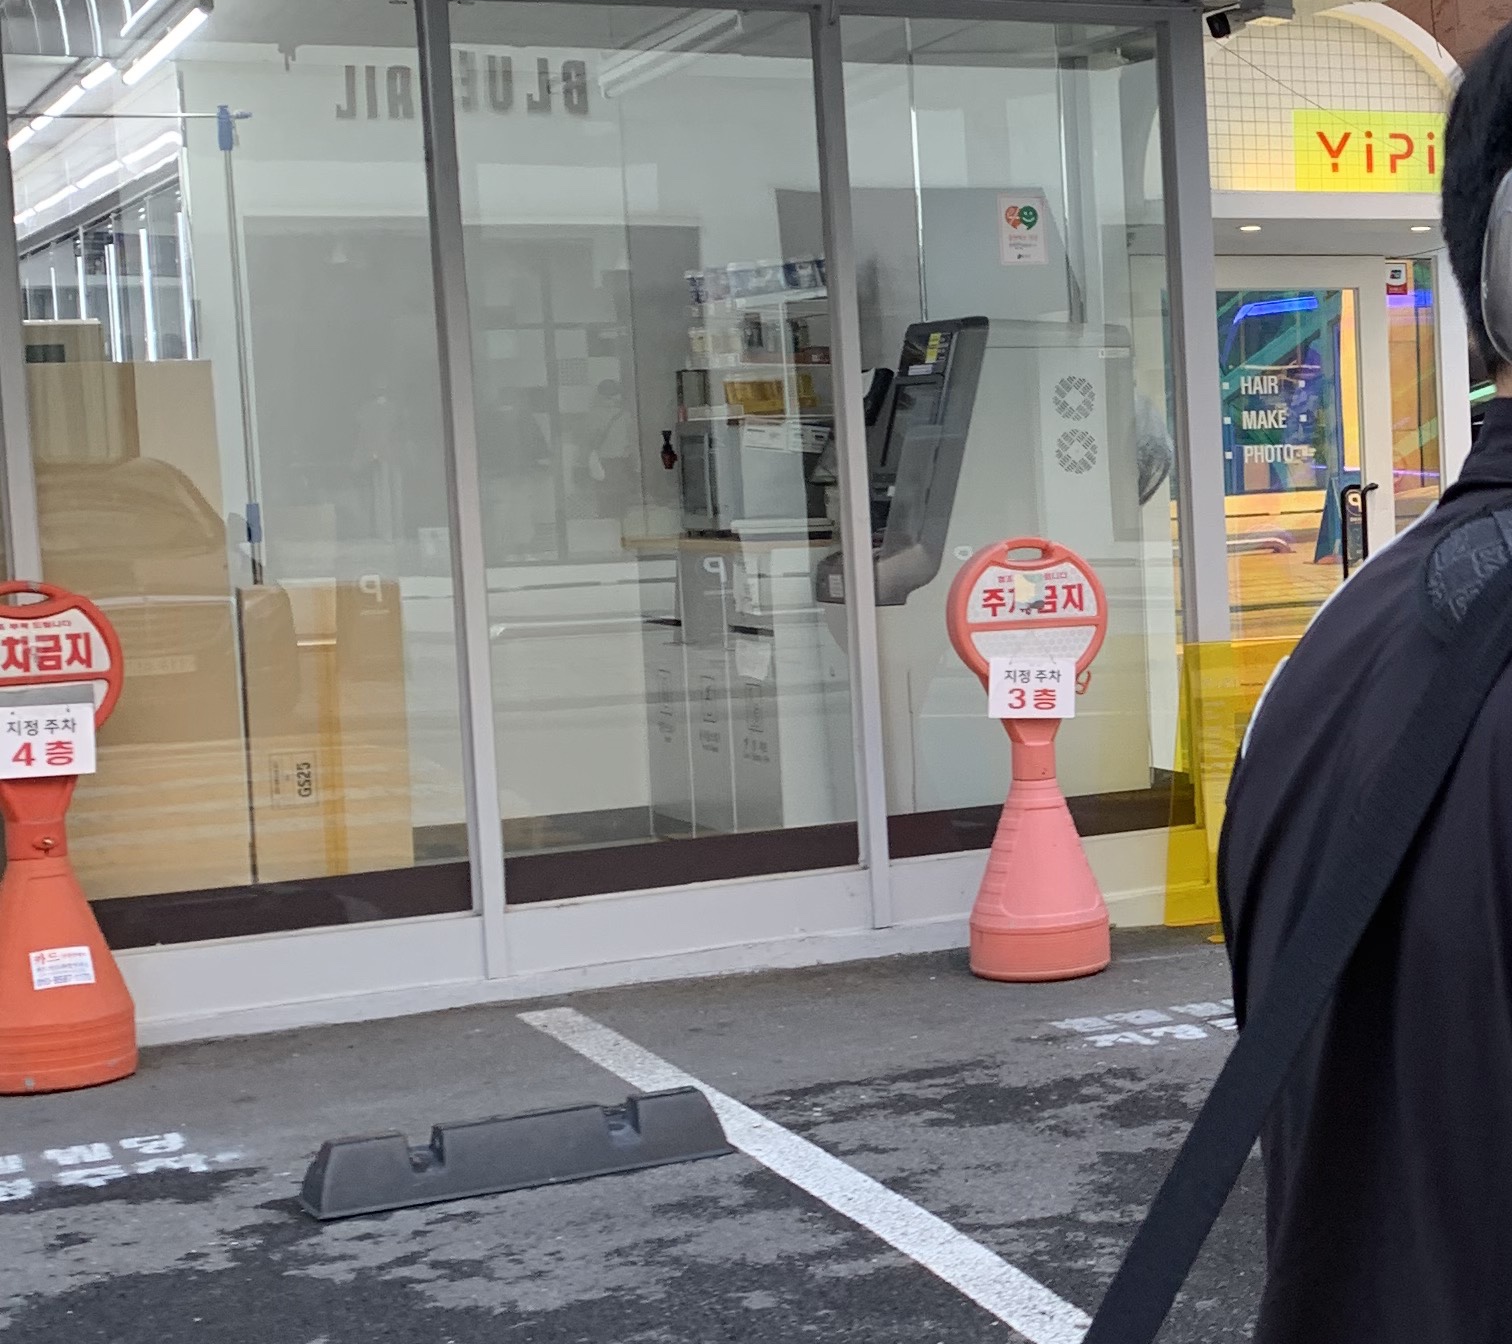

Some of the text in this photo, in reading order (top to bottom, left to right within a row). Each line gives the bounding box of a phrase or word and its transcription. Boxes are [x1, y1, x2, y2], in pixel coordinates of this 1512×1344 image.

[1316, 130, 1436, 175] YiPi
[1240, 376, 1279, 395] HAIR
[1242, 409, 1287, 430] MAKE
[1244, 444, 1295, 464] PHOTO
[1005, 670, 1061, 683] 지정 주차
[1009, 688, 1055, 709] 3 층
[7, 719, 76, 736] 지정 주차
[13, 741, 73, 766] 4 층
[297, 763, 312, 797] GS25
